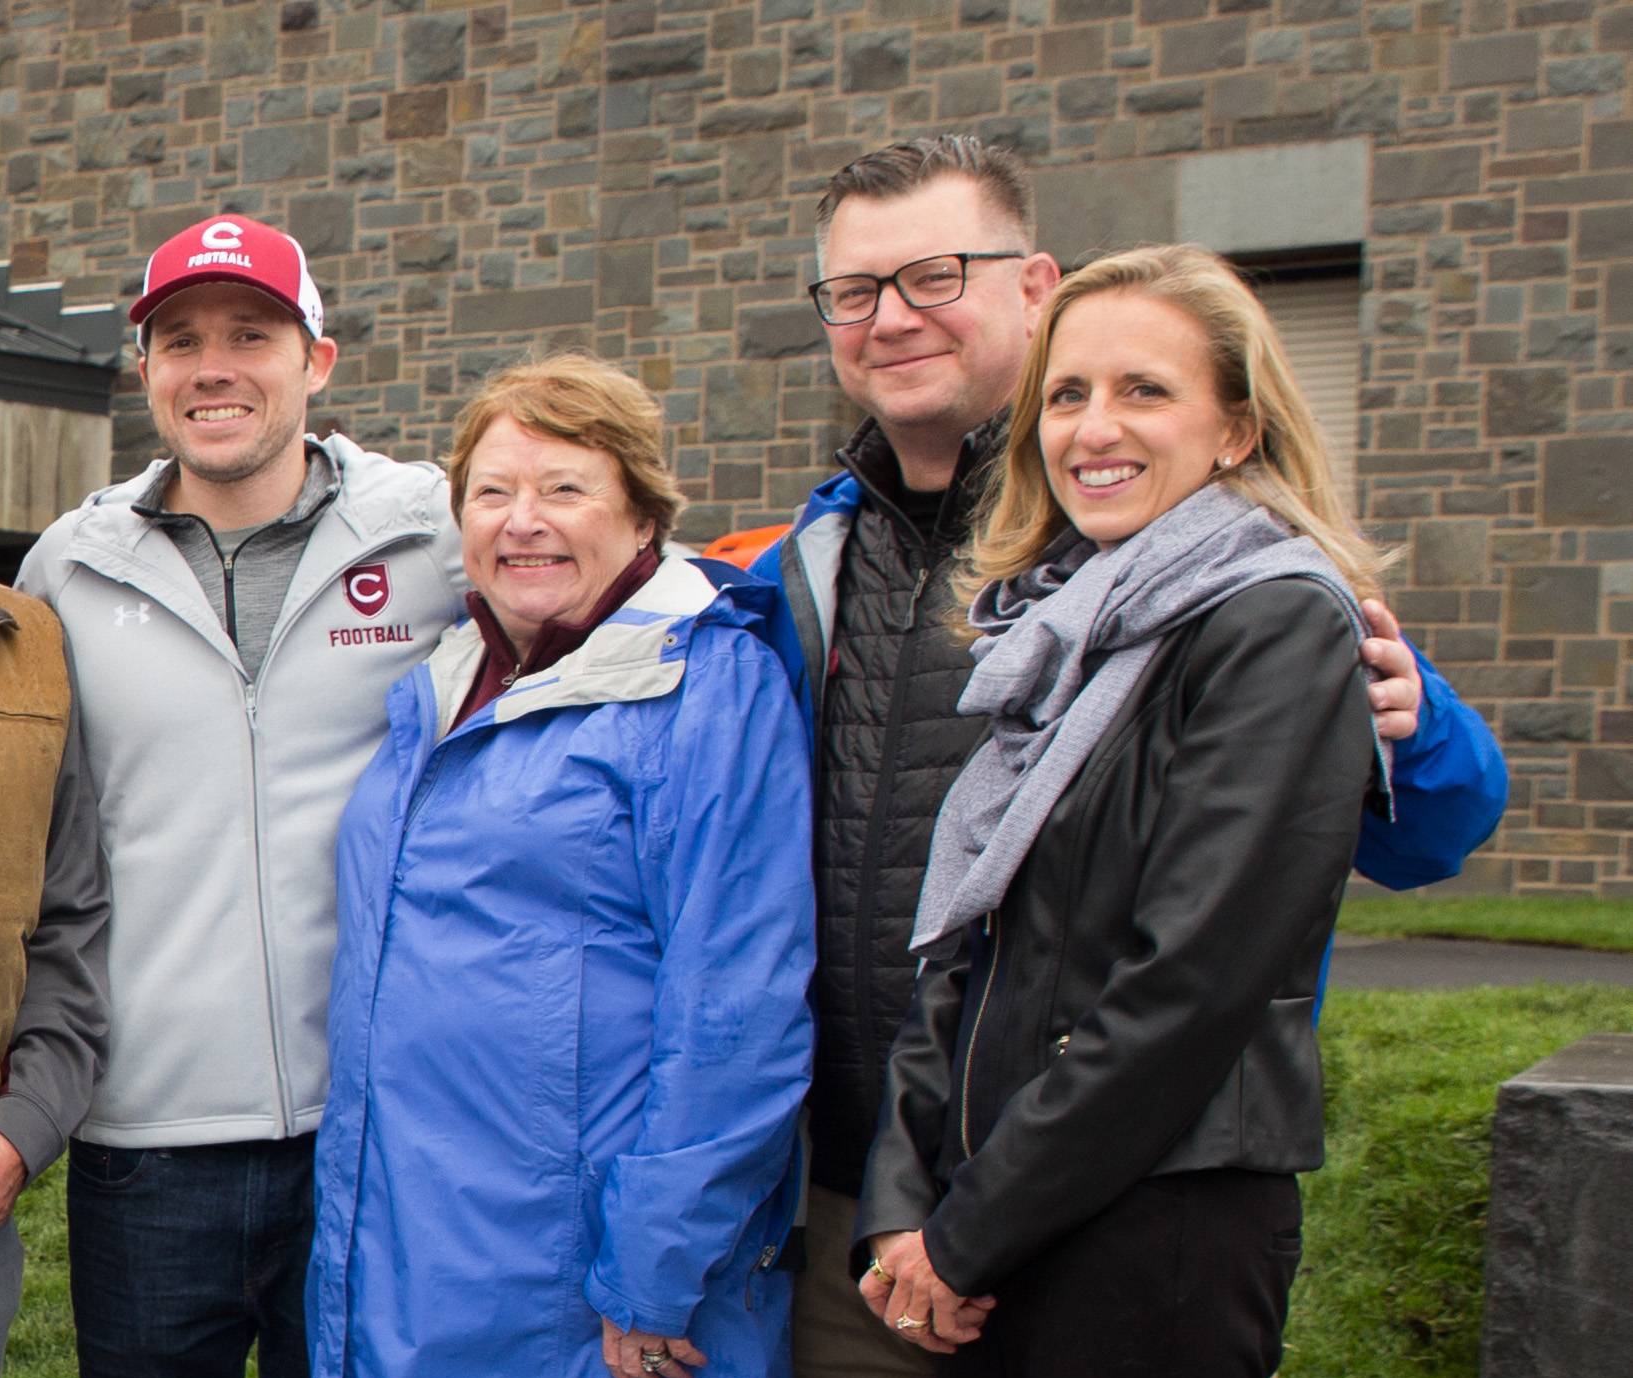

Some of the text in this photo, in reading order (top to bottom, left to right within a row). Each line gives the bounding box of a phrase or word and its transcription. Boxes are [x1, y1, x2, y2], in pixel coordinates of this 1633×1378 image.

[201, 221, 243, 249] C
[187, 251, 252, 268] FOOTBALL
[350, 573, 385, 604] C
[329, 624, 414, 647] FOOTBALL
